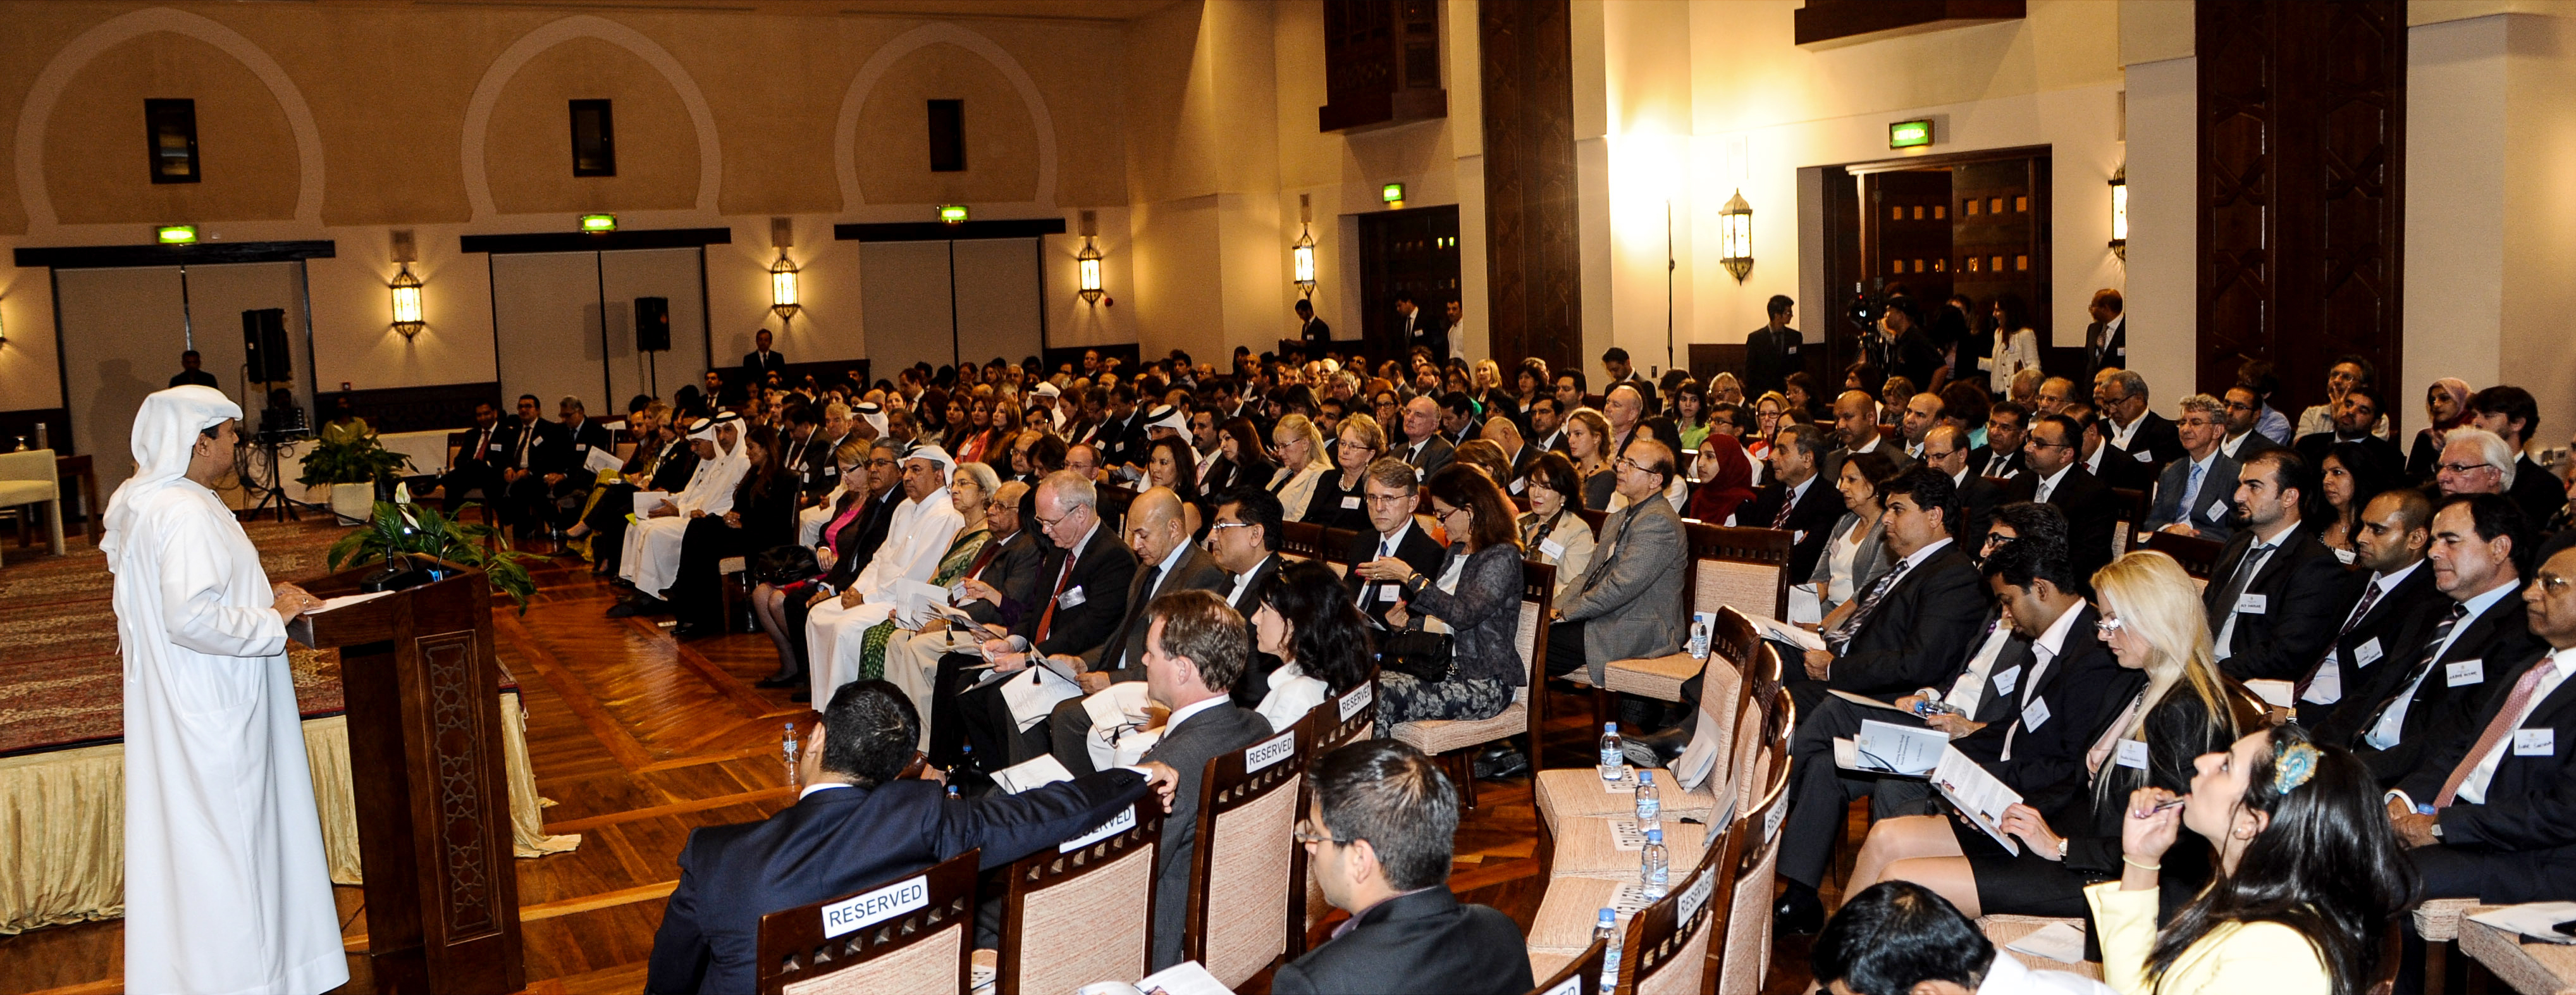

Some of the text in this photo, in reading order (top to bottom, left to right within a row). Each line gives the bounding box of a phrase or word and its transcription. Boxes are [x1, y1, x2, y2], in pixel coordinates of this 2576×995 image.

[1342, 684, 1371, 714] RESERVED
[1249, 738, 1292, 765] RESERVED
[829, 884, 921, 927] RESERVED
[1680, 872, 1713, 917] RESERVED
